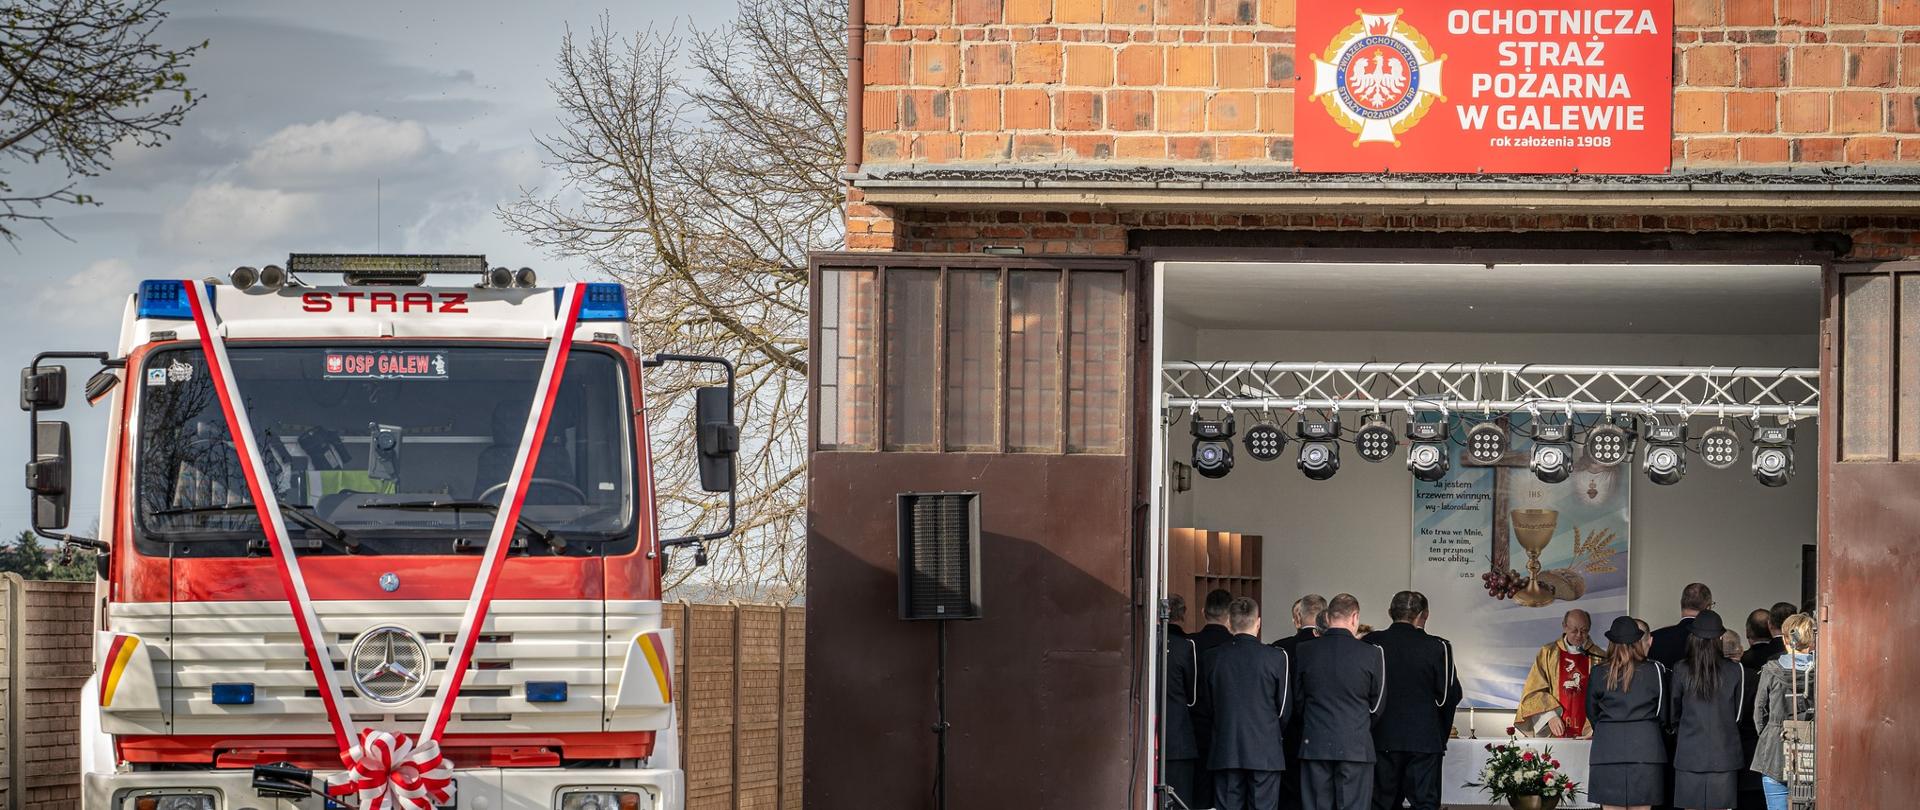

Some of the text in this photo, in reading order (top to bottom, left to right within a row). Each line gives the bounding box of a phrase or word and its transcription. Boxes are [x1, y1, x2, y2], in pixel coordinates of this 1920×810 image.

[1447, 9, 1658, 35] OCHOTNICZA
[1366, 37, 1418, 73] OCHOTNICZYCH
[1498, 35, 1605, 66] STRAŻ
[1472, 67, 1631, 99] POŻARNA
[1406, 87, 1416, 100] RP
[1456, 105, 1645, 130] W GALEWIE
[1490, 135, 1611, 147] rok założenia 1908
[345, 354, 430, 374] OSP GALEW
[1433, 480, 1472, 490] Ja jestem
[1416, 489, 1491, 503] krzewem winnym,
[1425, 504, 1436, 512] wy
[1420, 527, 1433, 535] Kto
[1464, 528, 1483, 537] Mnie,
[1456, 537, 1471, 545] nim,
[1443, 546, 1474, 555] przynosi
